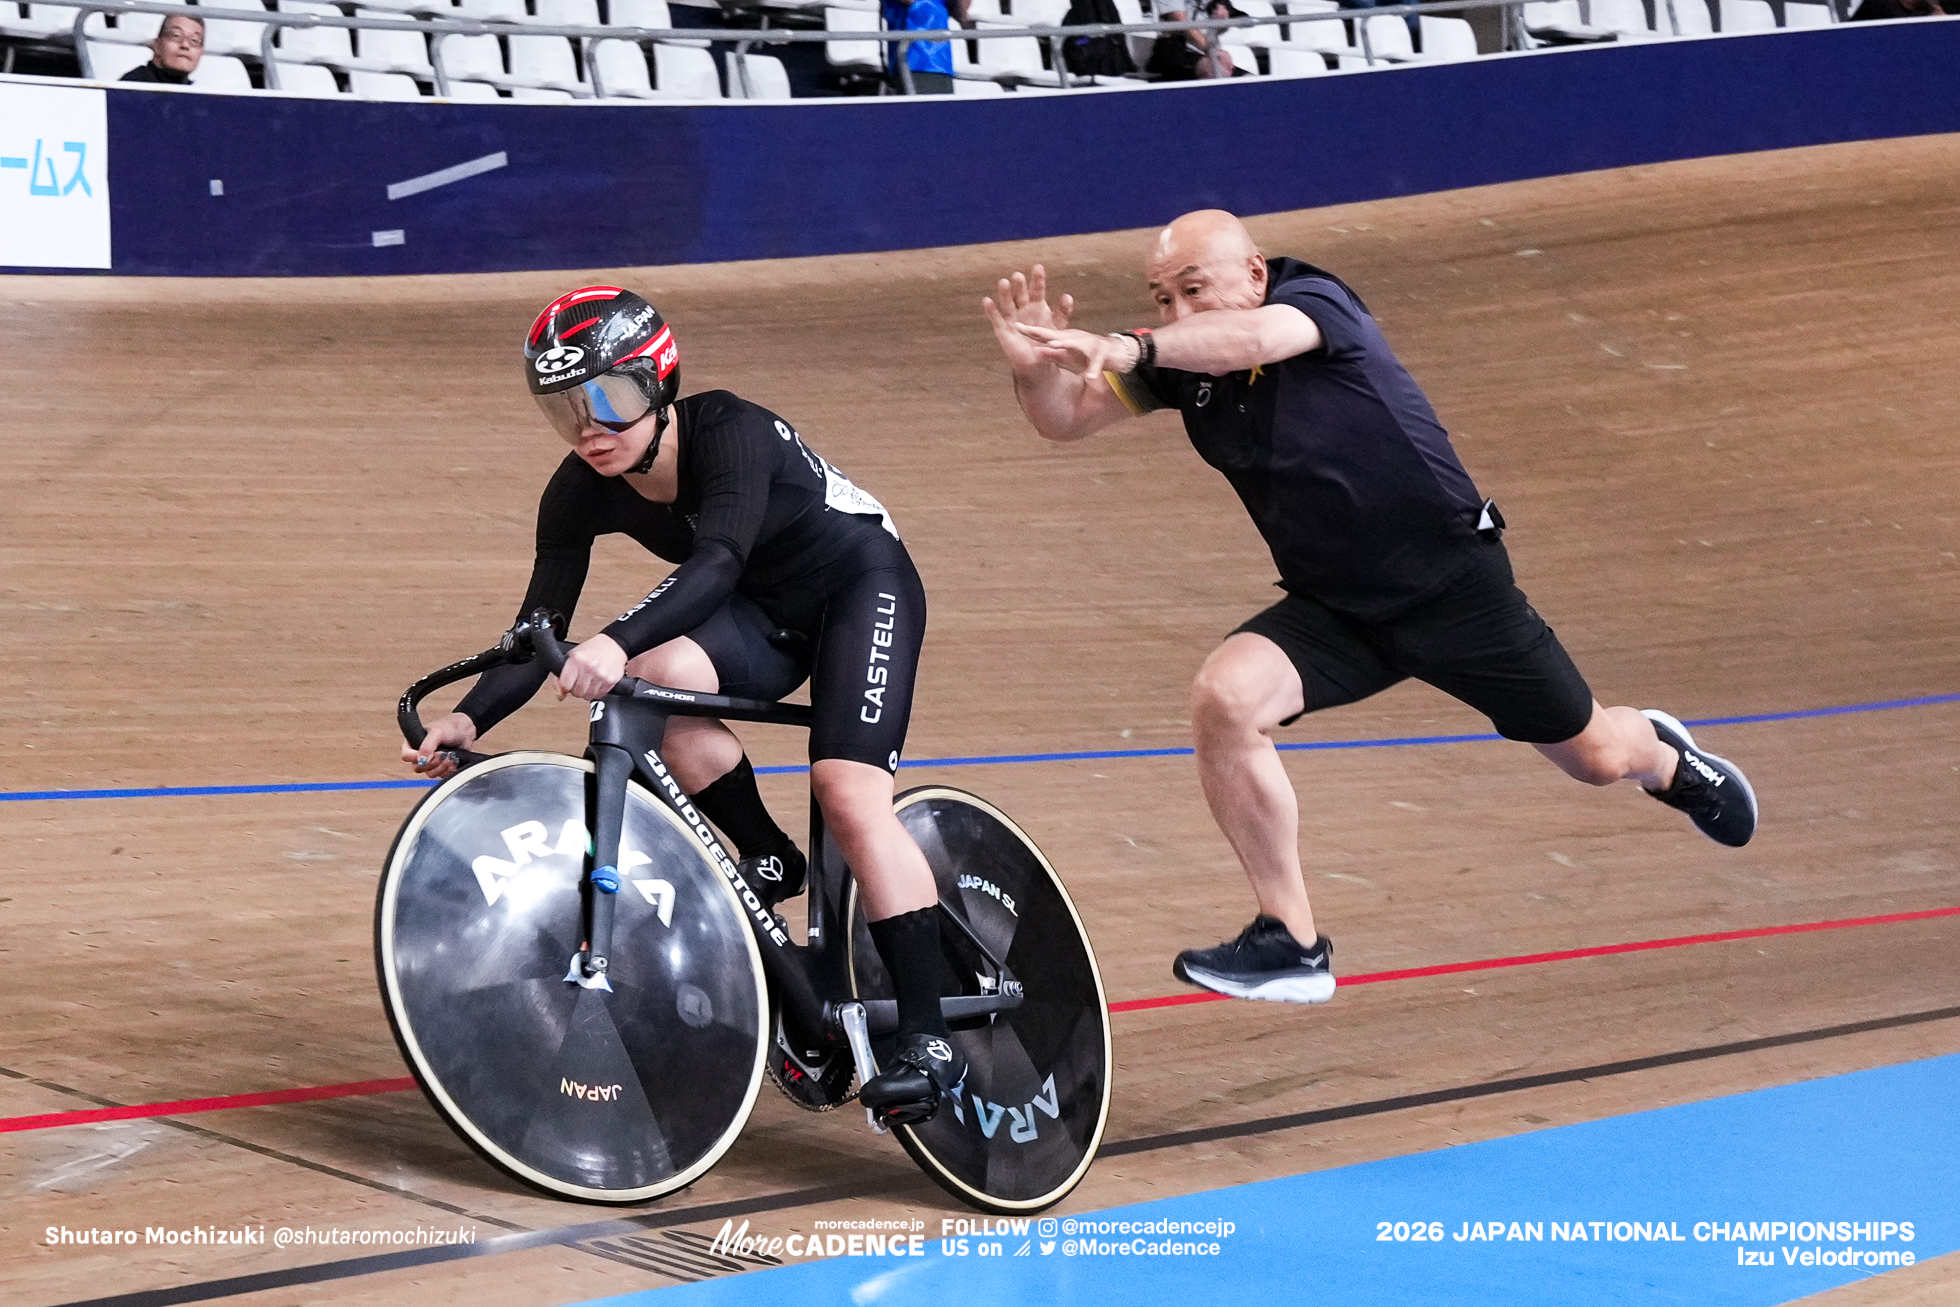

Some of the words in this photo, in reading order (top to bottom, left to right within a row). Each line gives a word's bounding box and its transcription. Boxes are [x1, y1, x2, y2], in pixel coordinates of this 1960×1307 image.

[620, 305, 656, 340] JAPAN
[538, 367, 587, 386] Kabuto
[617, 577, 678, 622] CASTELLI
[859, 592, 896, 724] CASTELLI
[642, 688, 696, 702] ANCHOR
[643, 749, 788, 947] BRIDGESTONE
[957, 873, 1001, 900] JAPAN
[1001, 893, 1019, 918] SL
[559, 1076, 623, 1102] JAPAN
